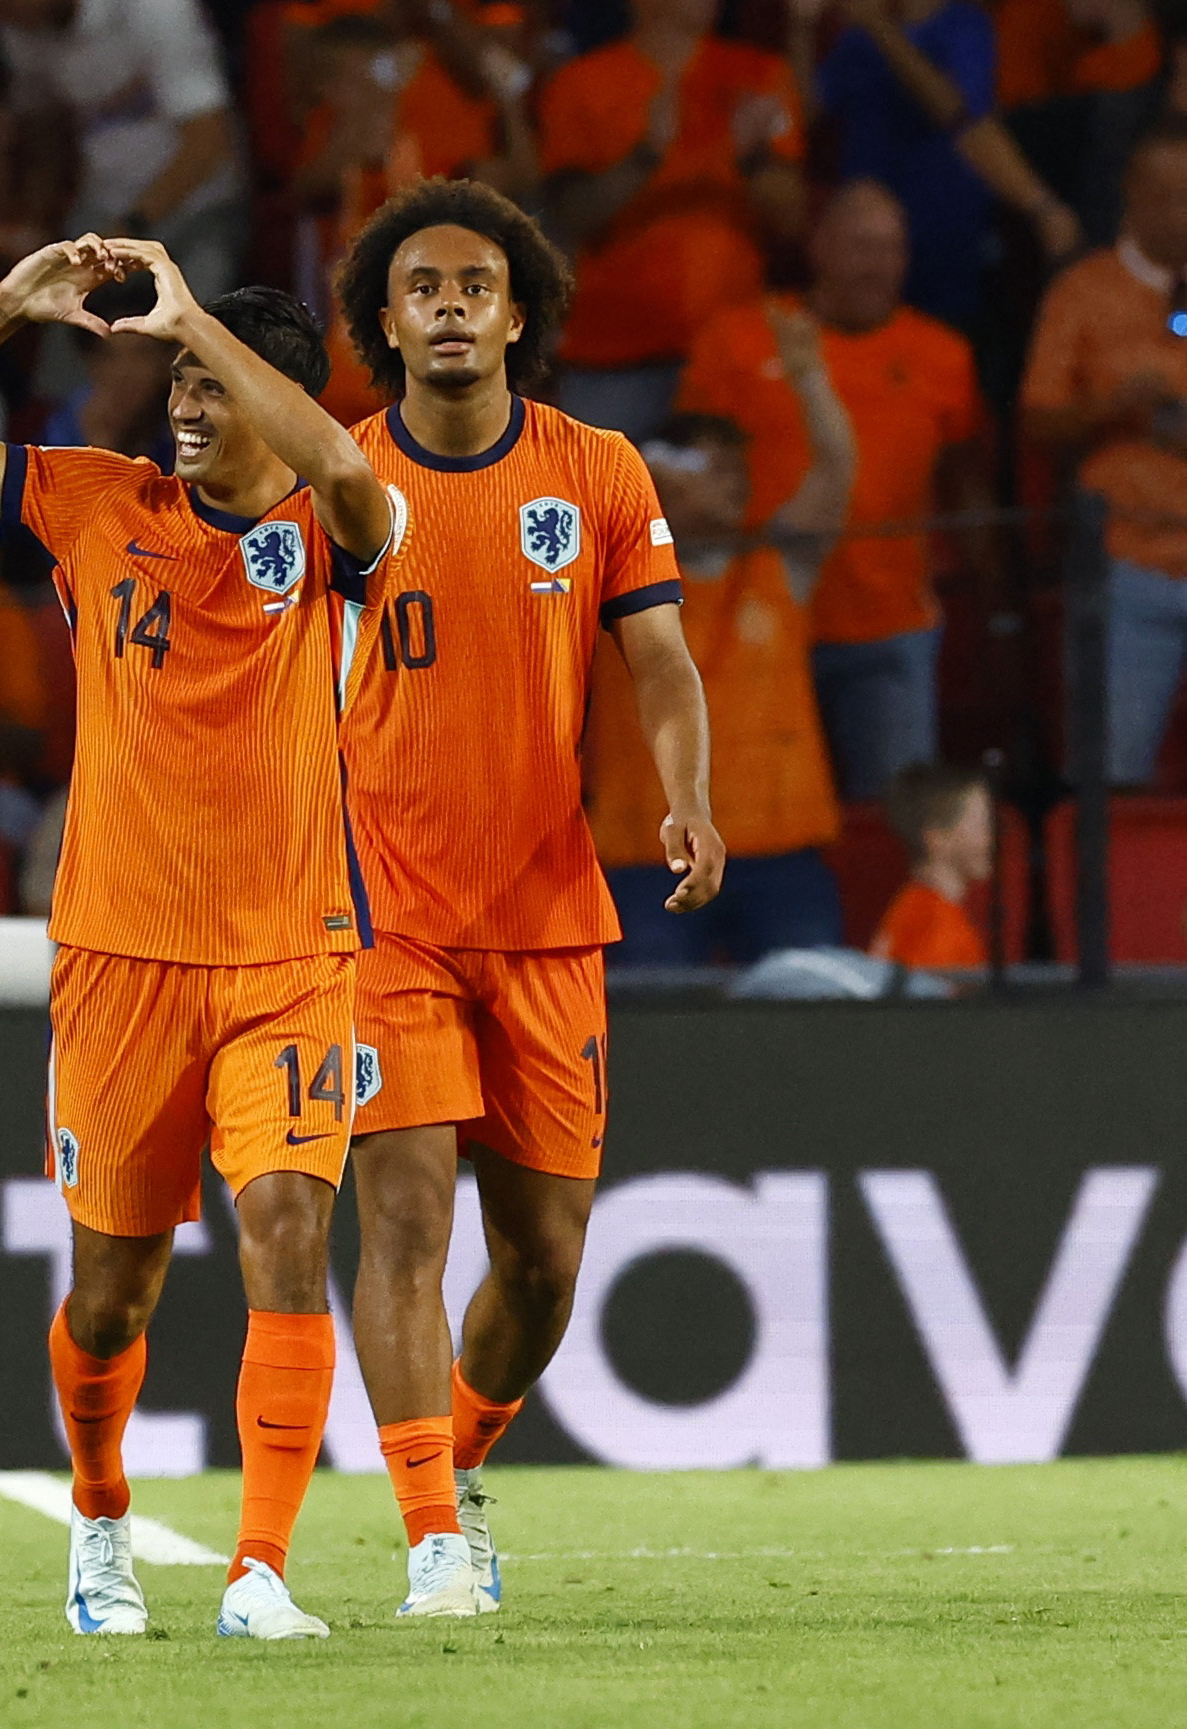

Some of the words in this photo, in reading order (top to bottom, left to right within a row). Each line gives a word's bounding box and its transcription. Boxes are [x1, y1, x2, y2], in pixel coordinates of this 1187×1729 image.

[110, 577, 171, 670] 14
[380, 590, 437, 671] 10
[274, 1043, 345, 1123] 14
[581, 1033, 608, 1115] 1
